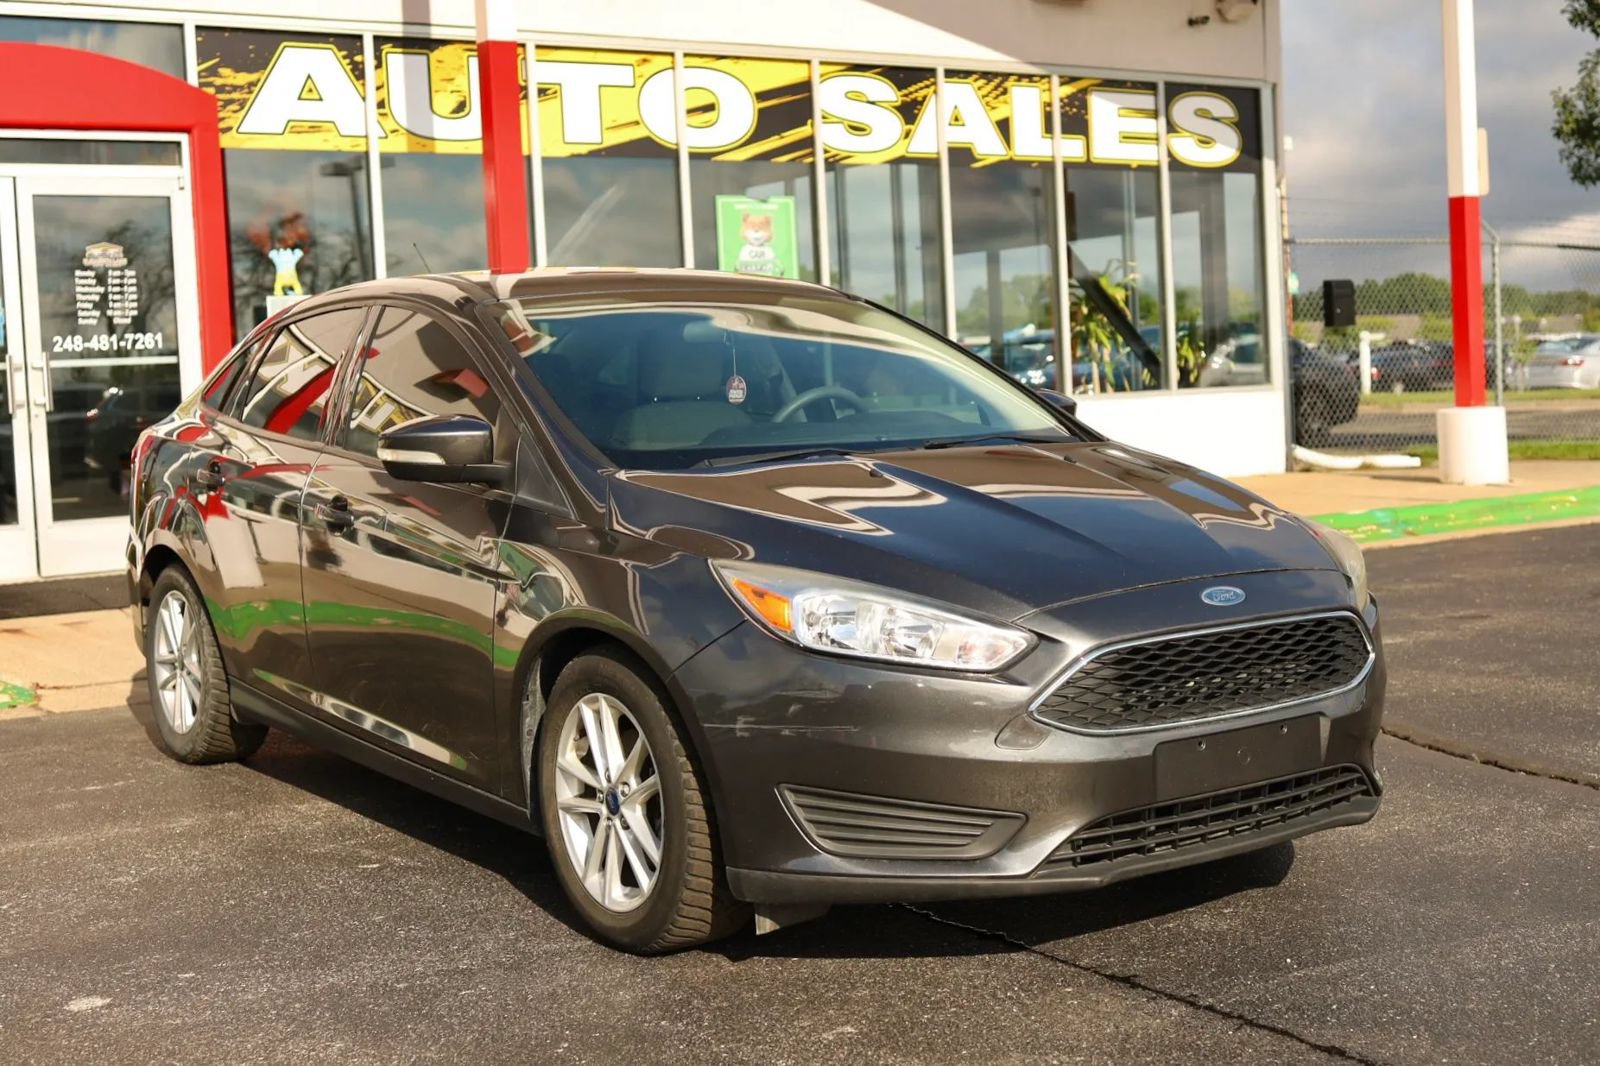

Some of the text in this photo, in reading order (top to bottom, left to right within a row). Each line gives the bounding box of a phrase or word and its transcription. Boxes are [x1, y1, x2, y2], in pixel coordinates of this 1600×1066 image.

[236, 42, 1243, 168] AUTO SALES
[52, 332, 163, 352] 248-481-7261
